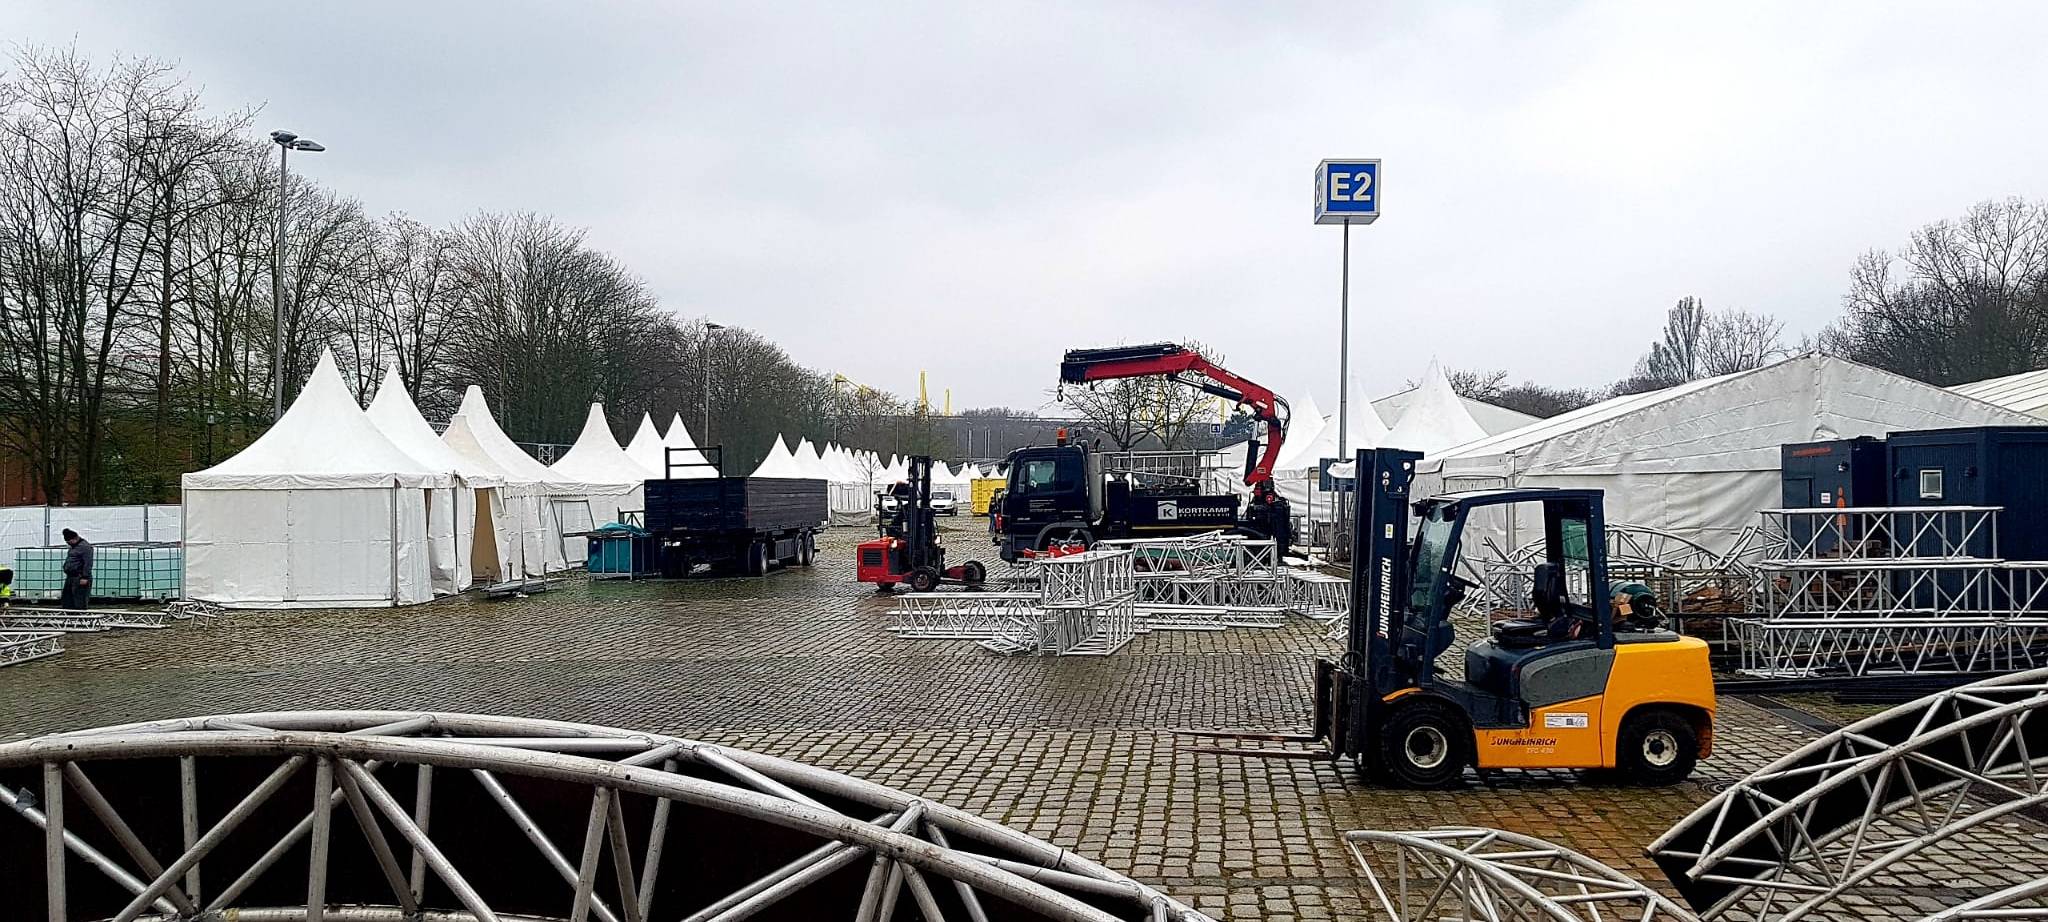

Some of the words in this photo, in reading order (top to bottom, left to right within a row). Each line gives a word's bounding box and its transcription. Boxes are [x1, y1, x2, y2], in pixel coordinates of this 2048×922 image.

[1331, 172, 1371, 201] E2
[1376, 557, 1392, 639] JUNGHEINRICH
[1491, 736, 1557, 746] JUNGHEINRICH
